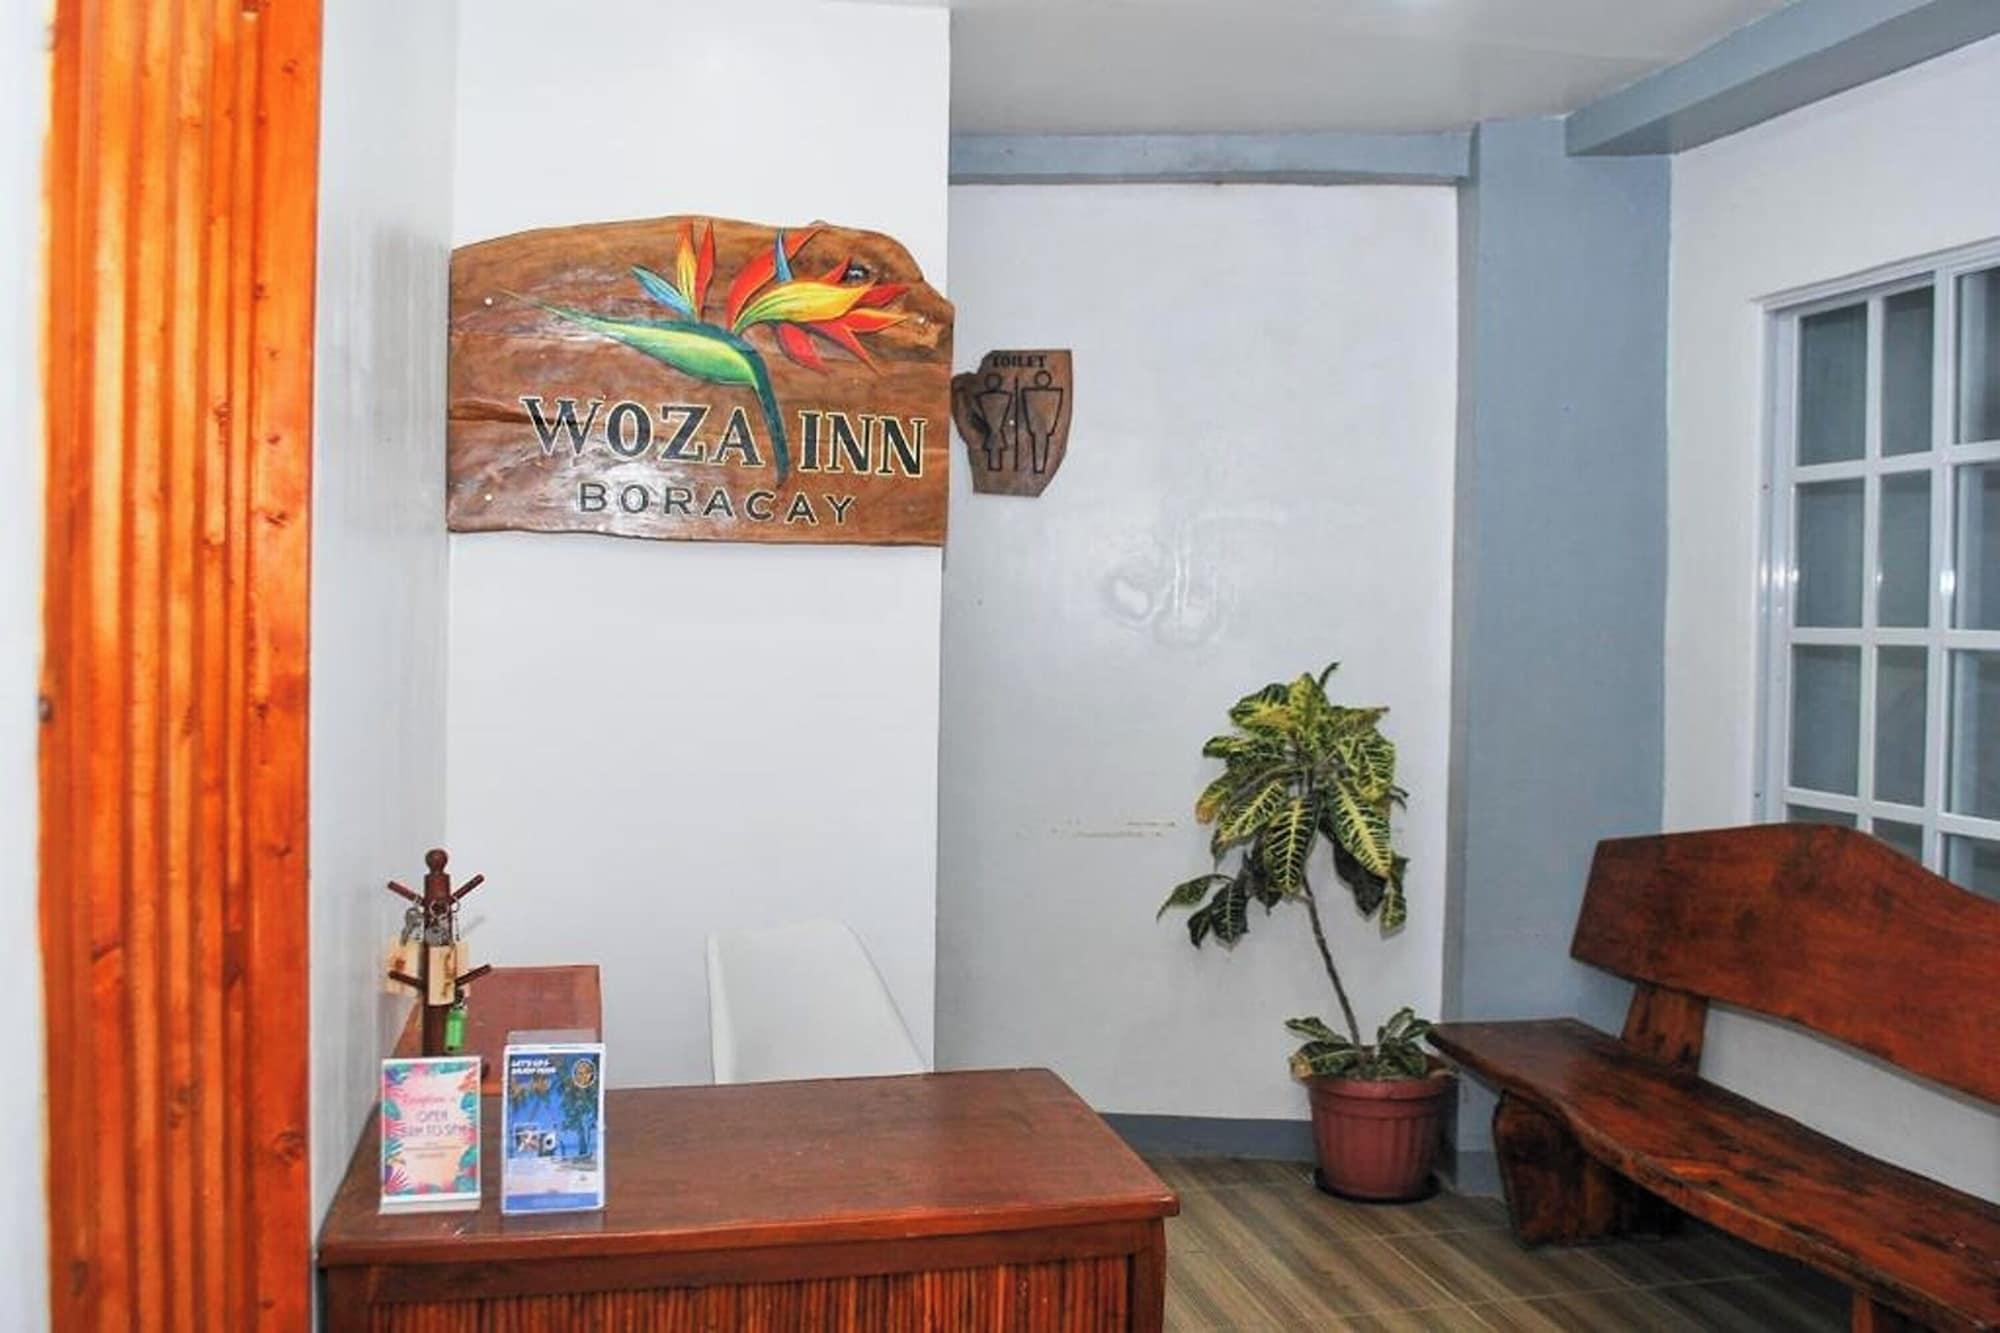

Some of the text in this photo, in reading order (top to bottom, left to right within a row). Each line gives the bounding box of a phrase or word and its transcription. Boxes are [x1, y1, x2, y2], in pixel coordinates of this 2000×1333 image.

[992, 354, 1048, 369] TOILET
[519, 396, 928, 477] WOZA INN
[577, 480, 856, 526] BORACAY
